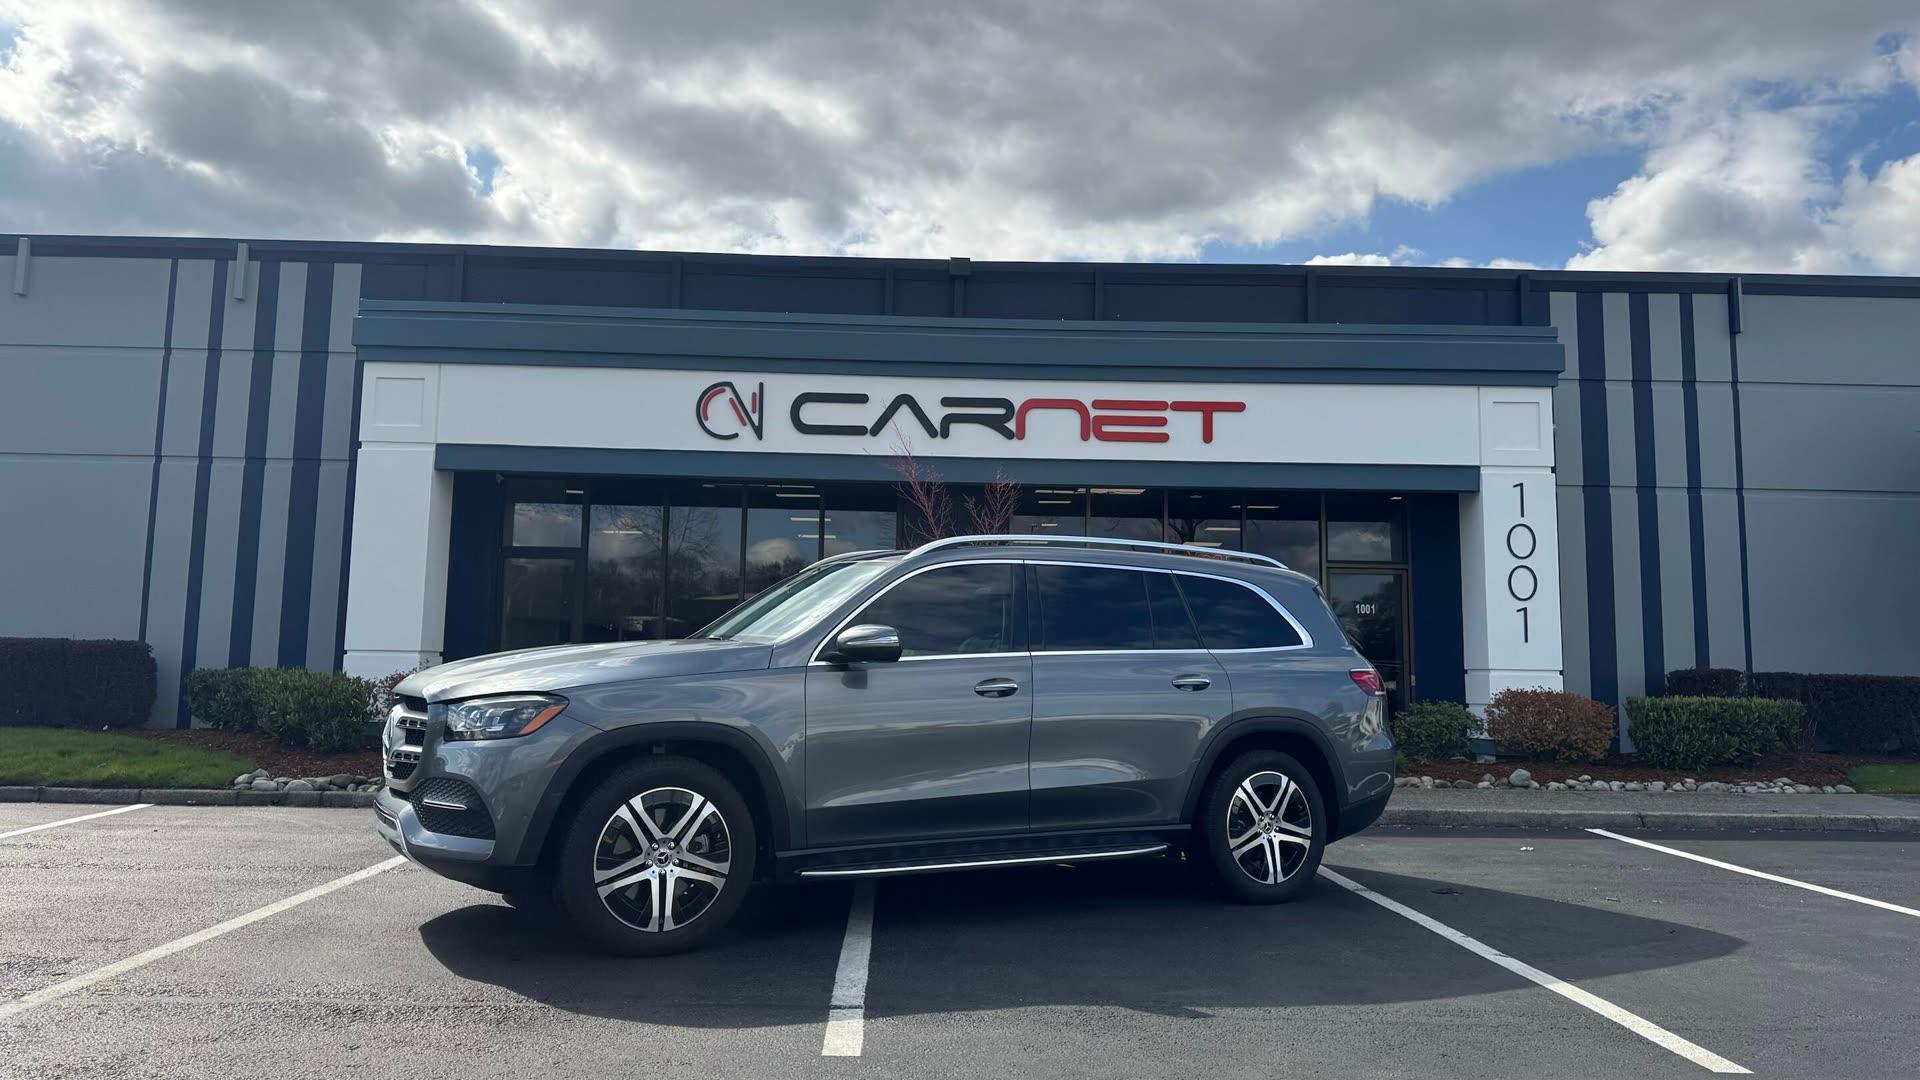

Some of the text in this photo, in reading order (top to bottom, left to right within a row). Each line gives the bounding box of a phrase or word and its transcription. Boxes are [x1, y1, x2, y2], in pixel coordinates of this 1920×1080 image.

[790, 391, 1246, 444] CARNET
[1506, 482, 1538, 643] 1001
[1355, 603, 1376, 615] 1001
